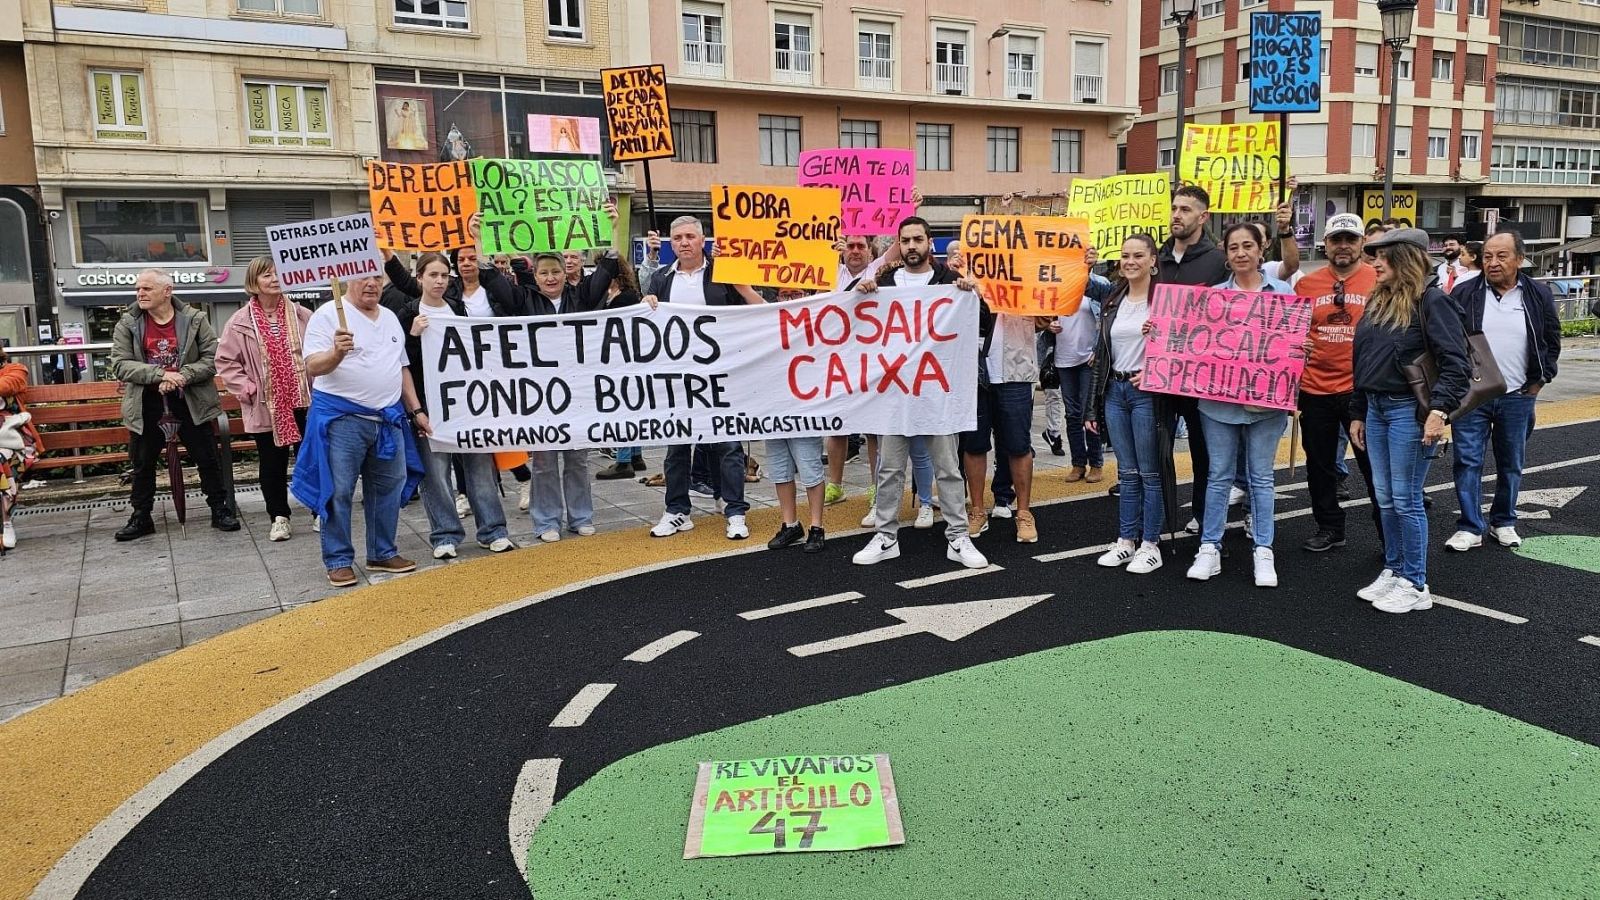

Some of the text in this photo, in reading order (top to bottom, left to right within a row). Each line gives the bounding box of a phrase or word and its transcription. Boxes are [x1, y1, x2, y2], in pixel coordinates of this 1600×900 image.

[1254, 14, 1320, 37] NUESTRO
[1253, 37, 1313, 60] HOGAR
[610, 68, 663, 91] DETRAS
[1253, 57, 1310, 78] NO ES
[1271, 72, 1295, 86] UN
[252, 89, 265, 129] ESCUELA
[607, 86, 663, 106] DE CADA
[608, 101, 664, 122] PUERTA
[612, 115, 668, 138] HAY UNA
[1185, 124, 1278, 154] FUERA
[372, 161, 472, 193] DERECH
[803, 155, 910, 177] GEMA TE DA
[1194, 154, 1281, 181] FONDO
[480, 189, 528, 215] AL?
[889, 187, 910, 204] EL
[1073, 178, 1166, 204] PEÑACASTILLO
[379, 195, 461, 217] A UN
[872, 207, 900, 228] 47
[1094, 207, 1108, 224] SE
[270, 218, 370, 242] DETRAS DE CADA
[486, 214, 611, 252] TOTAL
[965, 219, 1083, 250] GEMA TE DA
[279, 237, 369, 264] PUERTA HAY
[715, 237, 788, 260] ESTAFA
[282, 258, 378, 286] UNA FAMILIA
[758, 262, 830, 286] TOTAL
[966, 252, 1062, 283] IGUAL EL
[984, 282, 1059, 311] ART. 47
[1344, 293, 1366, 306] OAST
[779, 297, 958, 350] MOSAIC
[1151, 286, 1312, 337] INMOCAIXA
[438, 315, 720, 372] AFECTADOS
[1166, 320, 1284, 365] MOSAIC
[787, 351, 950, 400] CAIXA
[1144, 356, 1301, 407] ESPECULACIÓN
[440, 373, 731, 422] FONDO BUITRE
[457, 423, 571, 449] HERMANOS
[712, 412, 843, 436] PEÑACASTILLO
[777, 775, 804, 787] EL
[749, 811, 828, 848] 47
